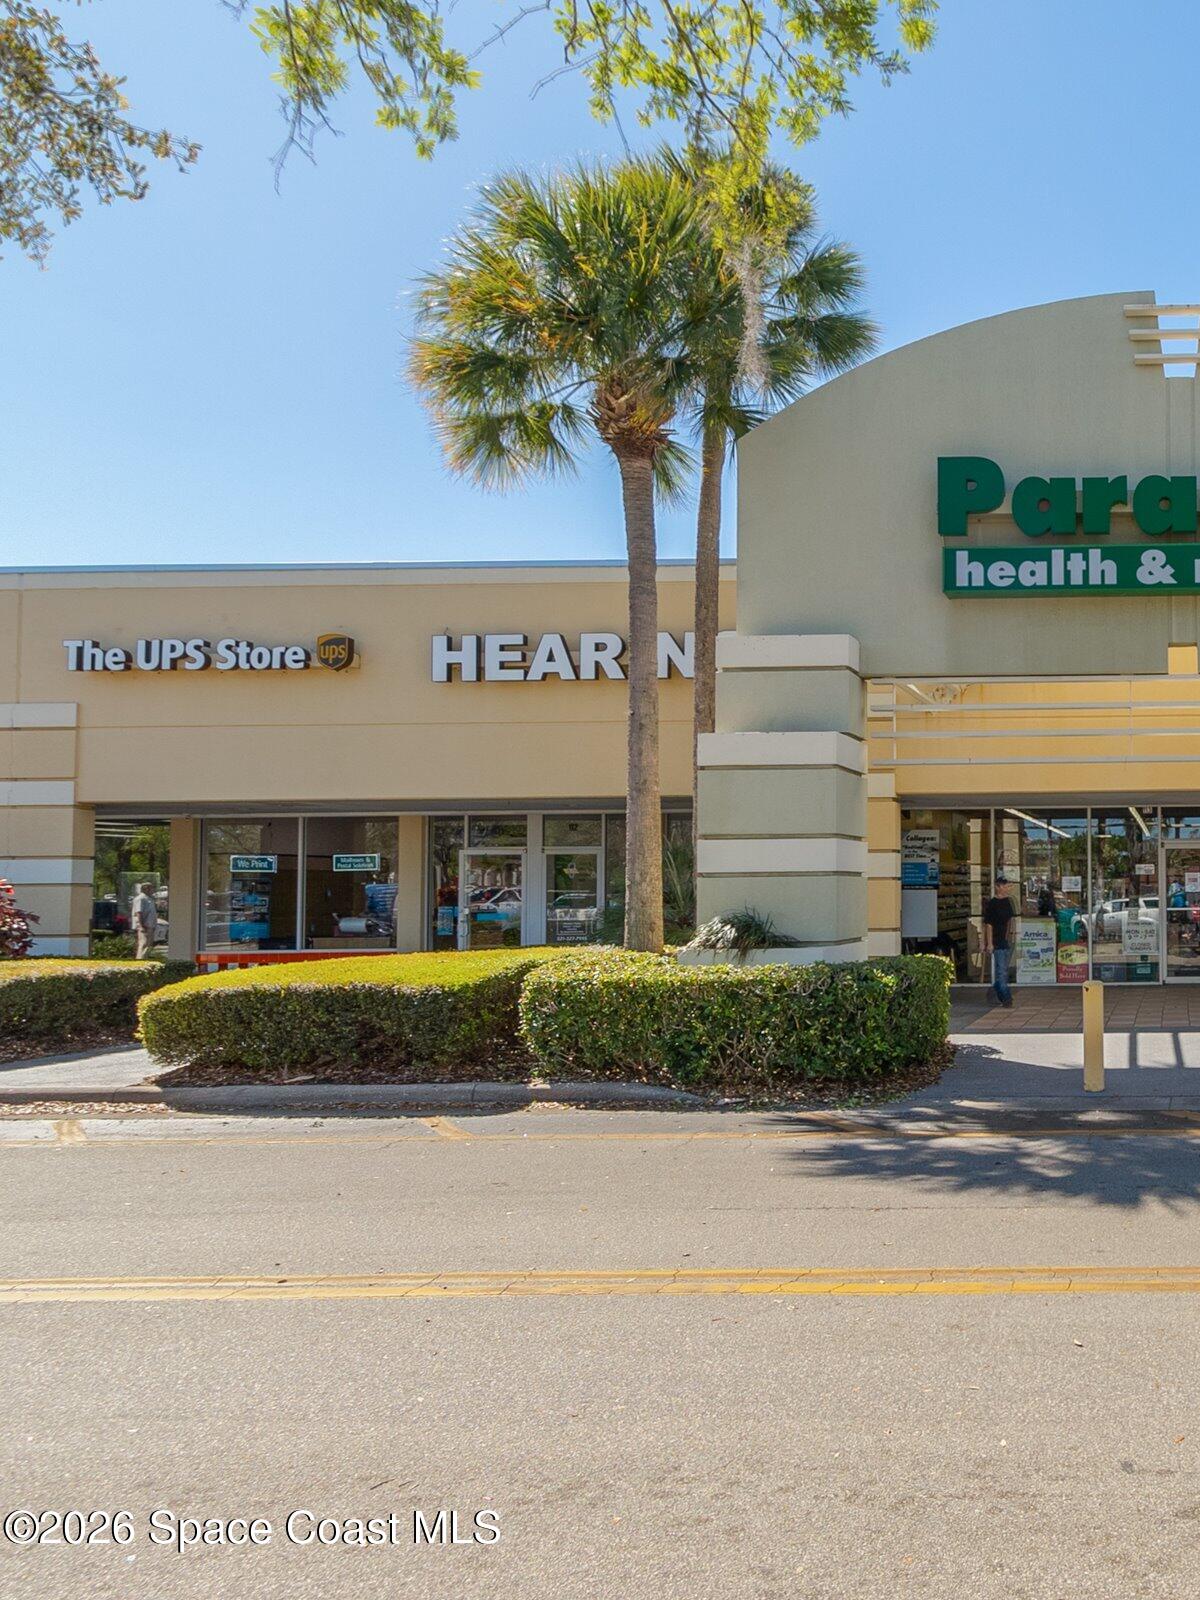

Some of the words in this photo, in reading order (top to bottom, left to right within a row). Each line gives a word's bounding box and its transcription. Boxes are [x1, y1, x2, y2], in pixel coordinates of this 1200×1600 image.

[955, 548, 1118, 588] health
[1136, 548, 1178, 586] &
[63, 639, 131, 672] The
[136, 638, 211, 672] UPS
[216, 638, 309, 671] Store
[320, 643, 347, 661] ups
[432, 631, 696, 683] HEARN
[237, 859, 249, 868] We
[250, 859, 269, 868] Print
[1023, 930, 1048, 938] Arnica
